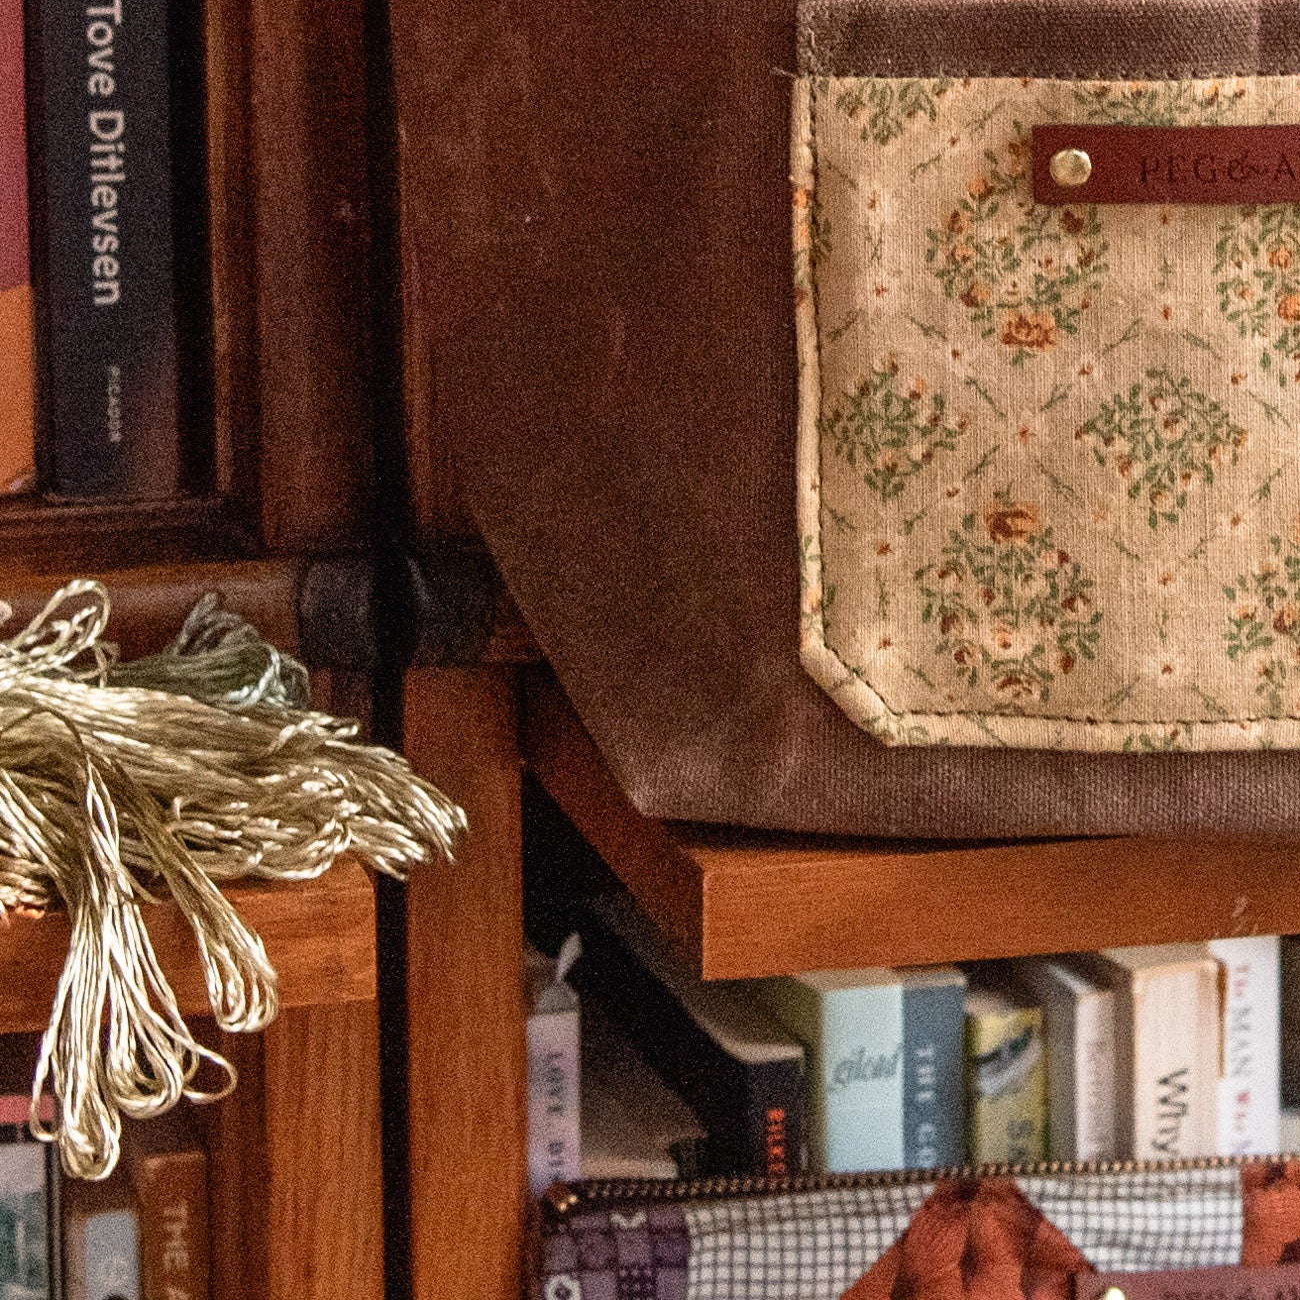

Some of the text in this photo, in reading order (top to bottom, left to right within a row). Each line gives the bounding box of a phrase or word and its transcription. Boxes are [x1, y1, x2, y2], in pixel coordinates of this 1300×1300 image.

[1139, 153, 1218, 184] PEG
[87, 110, 127, 306] Ditlevsen
[1229, 1005, 1255, 1078] MAN
[1151, 1067, 1190, 1160] Why
[163, 1200, 189, 1270] THE
